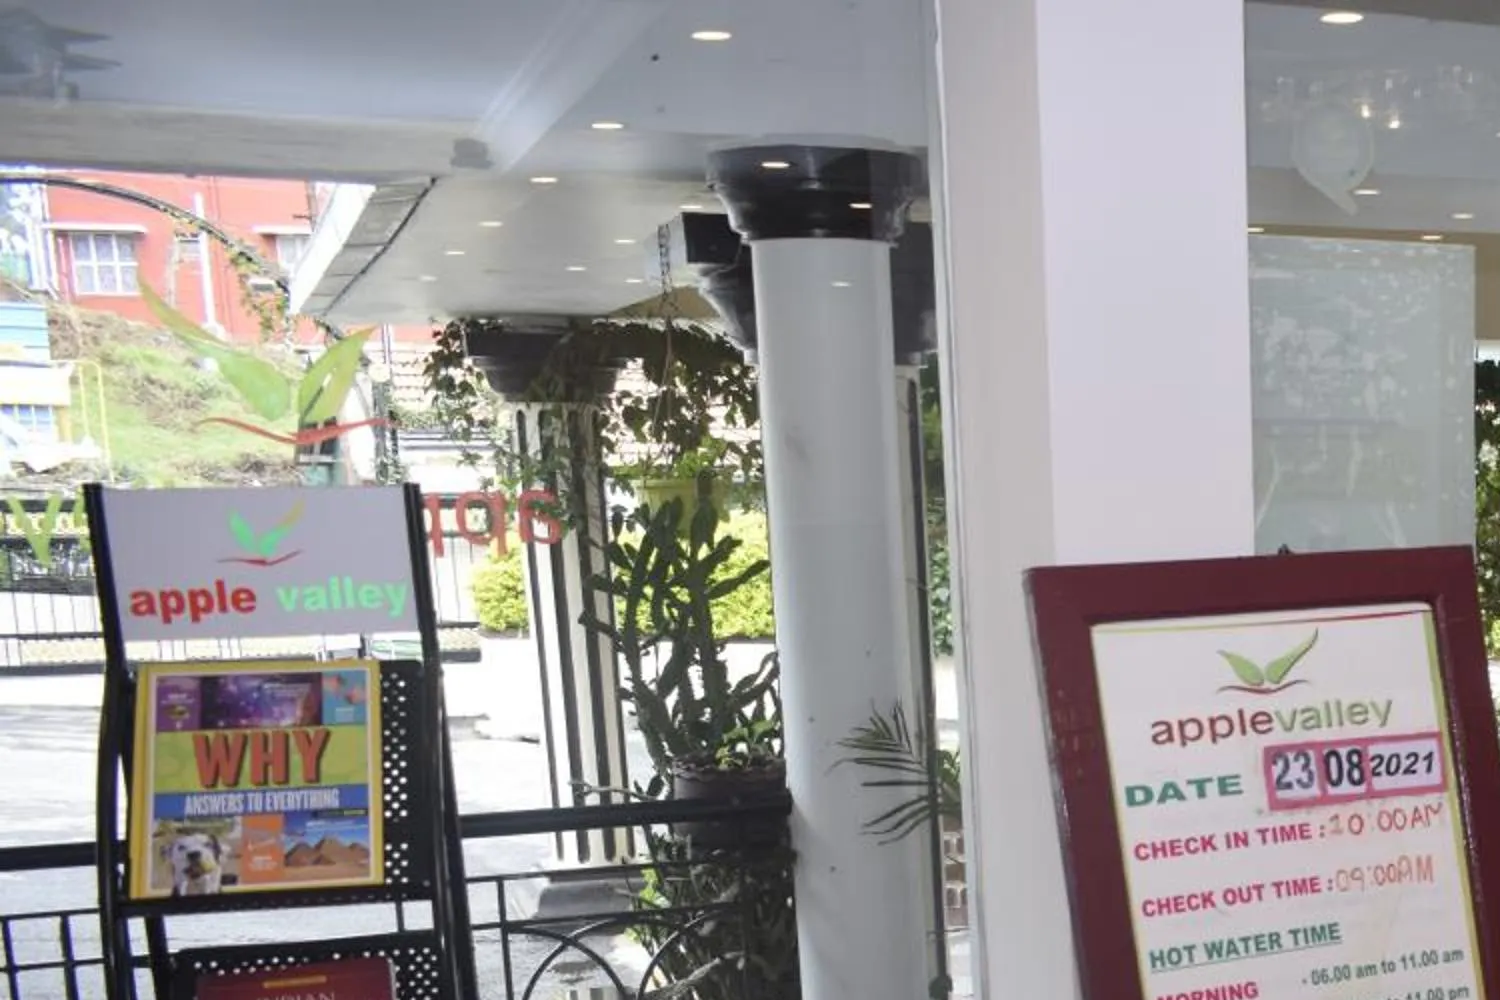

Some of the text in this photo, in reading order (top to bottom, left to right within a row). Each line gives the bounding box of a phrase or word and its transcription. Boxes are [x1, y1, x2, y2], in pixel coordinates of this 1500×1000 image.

[129, 576, 409, 624] apple valley
[192, 728, 331, 789] WHY
[1125, 748, 1436, 808] DATE 23 08 2021
[184, 788, 340, 816] ANSWERS TO EVERYTHING
[1134, 837, 1218, 862] CHECK
[1225, 829, 1250, 849] IN
[1257, 823, 1313, 845] TIME
[1142, 887, 1217, 918] CHECK
[1224, 884, 1265, 907] OUT
[1272, 876, 1321, 899] TIME
[1150, 923, 1341, 968] HOT WATER TIME
[1311, 963, 1352, 987] 06.00
[1355, 962, 1379, 979] am
[1381, 958, 1397, 974] to
[1400, 949, 1440, 971] 11.00
[1442, 947, 1465, 964] am
